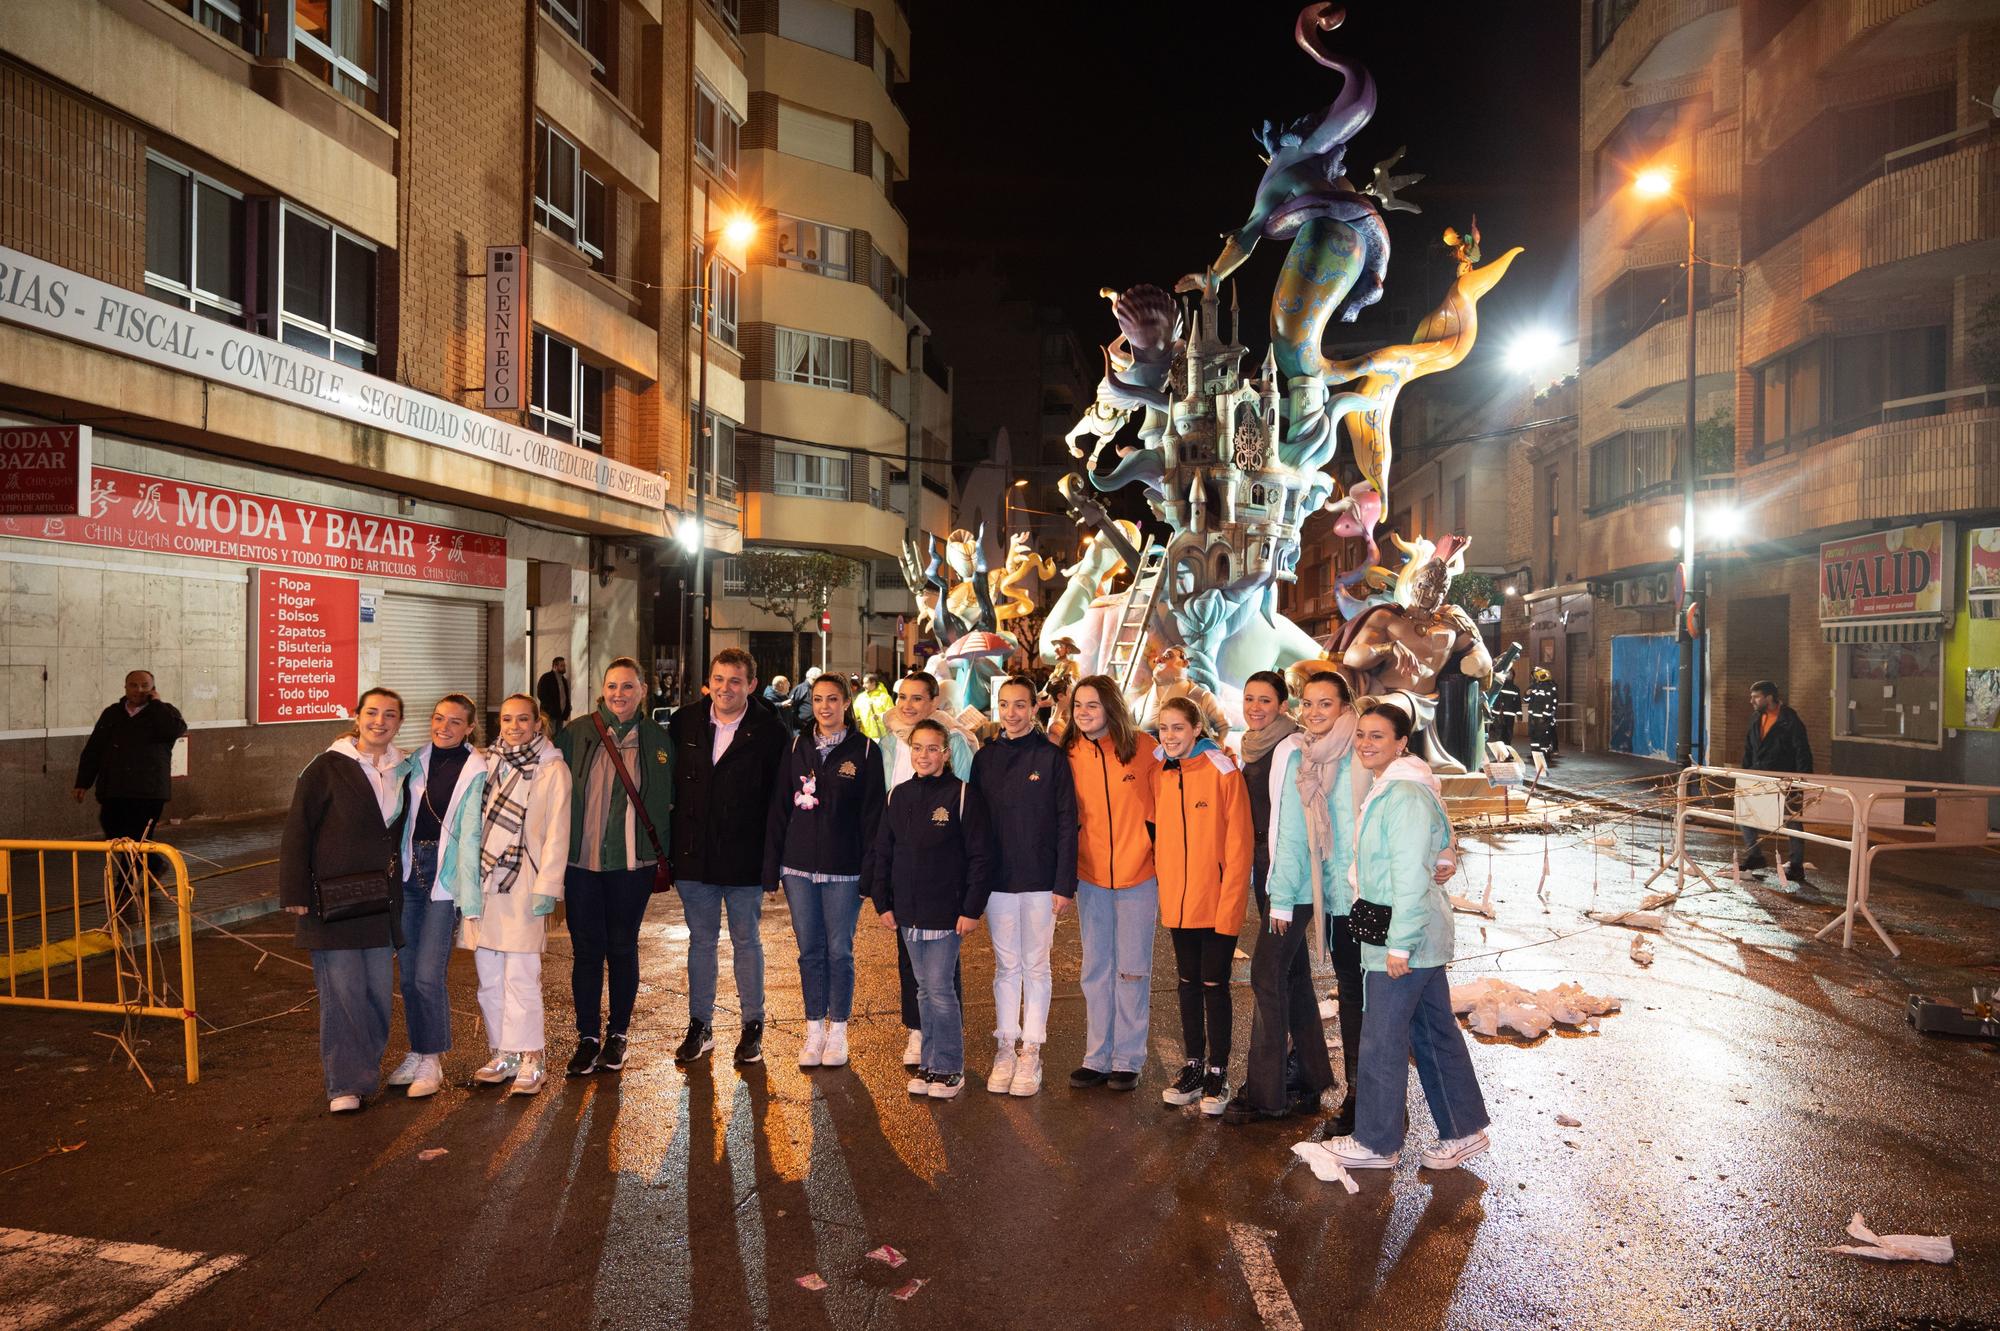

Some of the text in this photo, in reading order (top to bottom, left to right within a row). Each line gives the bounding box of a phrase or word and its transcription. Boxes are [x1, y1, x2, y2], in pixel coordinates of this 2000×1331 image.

[494, 276, 512, 404] CENTECO
[94, 296, 200, 361] FISCAL
[220, 339, 345, 404] CONTABLE
[358, 384, 459, 439] SEGURIDAD
[461, 418, 514, 457] SOCIAL
[523, 439, 600, 484] CORREDURIA
[600, 464, 616, 489] DE
[618, 472, 662, 502] SEGUROS
[58, 431, 74, 448] Y
[176, 487, 416, 559] MODA Y BAZAR
[84, 523, 170, 548] CHIN YUAN
[174, 535, 417, 577] COMPLEMENTOS Y TODO TIPO DE ARTICULOS
[1824, 549, 1931, 602] WALID
[279, 577, 311, 593] Ropa
[278, 593, 316, 609] Hogar
[278, 609, 320, 623] Bolsos
[278, 624, 326, 640] Zapatos
[278, 641, 332, 654] Bisuteria
[278, 656, 333, 671] Papeleria
[278, 672, 336, 684] Ferreteria
[278, 688, 305, 700] Todo
[308, 687, 330, 701] tipo
[278, 704, 293, 716] de
